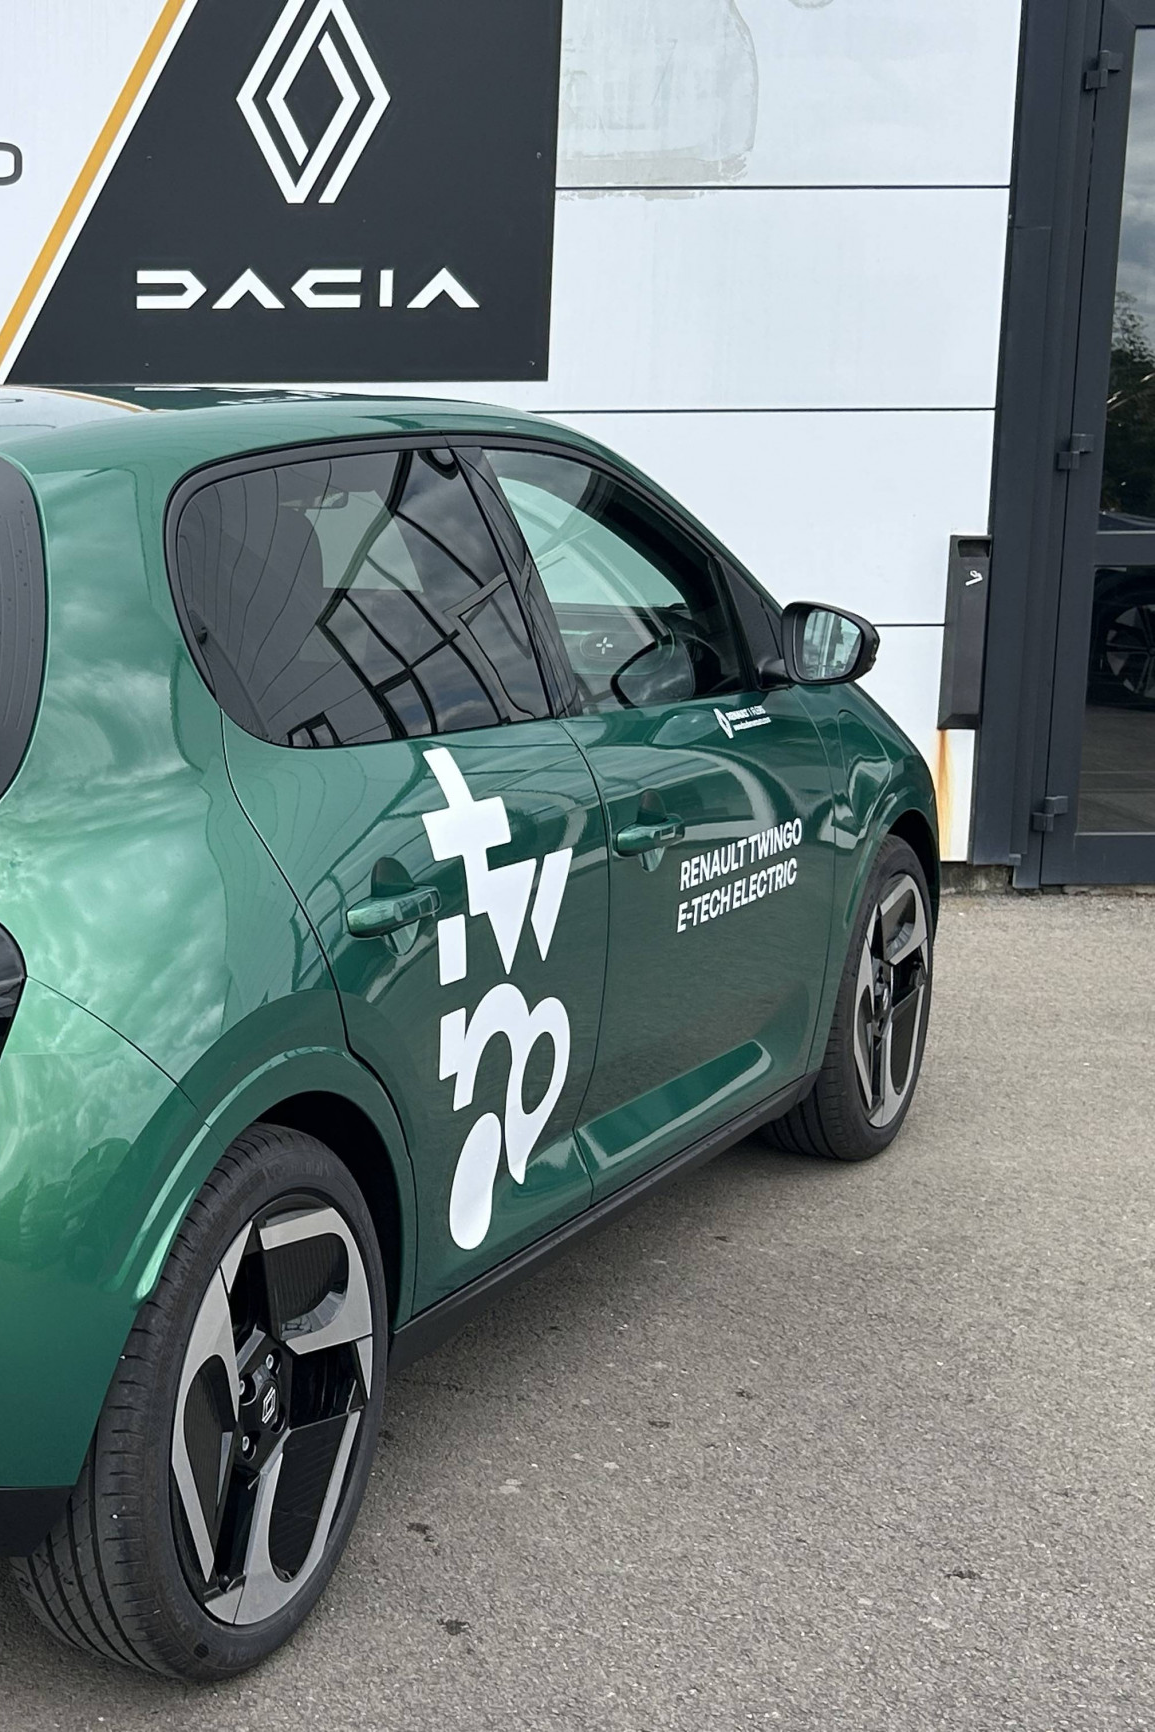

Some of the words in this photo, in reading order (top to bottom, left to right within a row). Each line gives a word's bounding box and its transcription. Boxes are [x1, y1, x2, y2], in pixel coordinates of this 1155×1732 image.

[136, 267, 480, 310] DACIA
[679, 838, 748, 892] RENAULT
[748, 817, 803, 864] TWINGO
[676, 883, 732, 934] E-TECH
[732, 857, 798, 910] ELECTRIC
